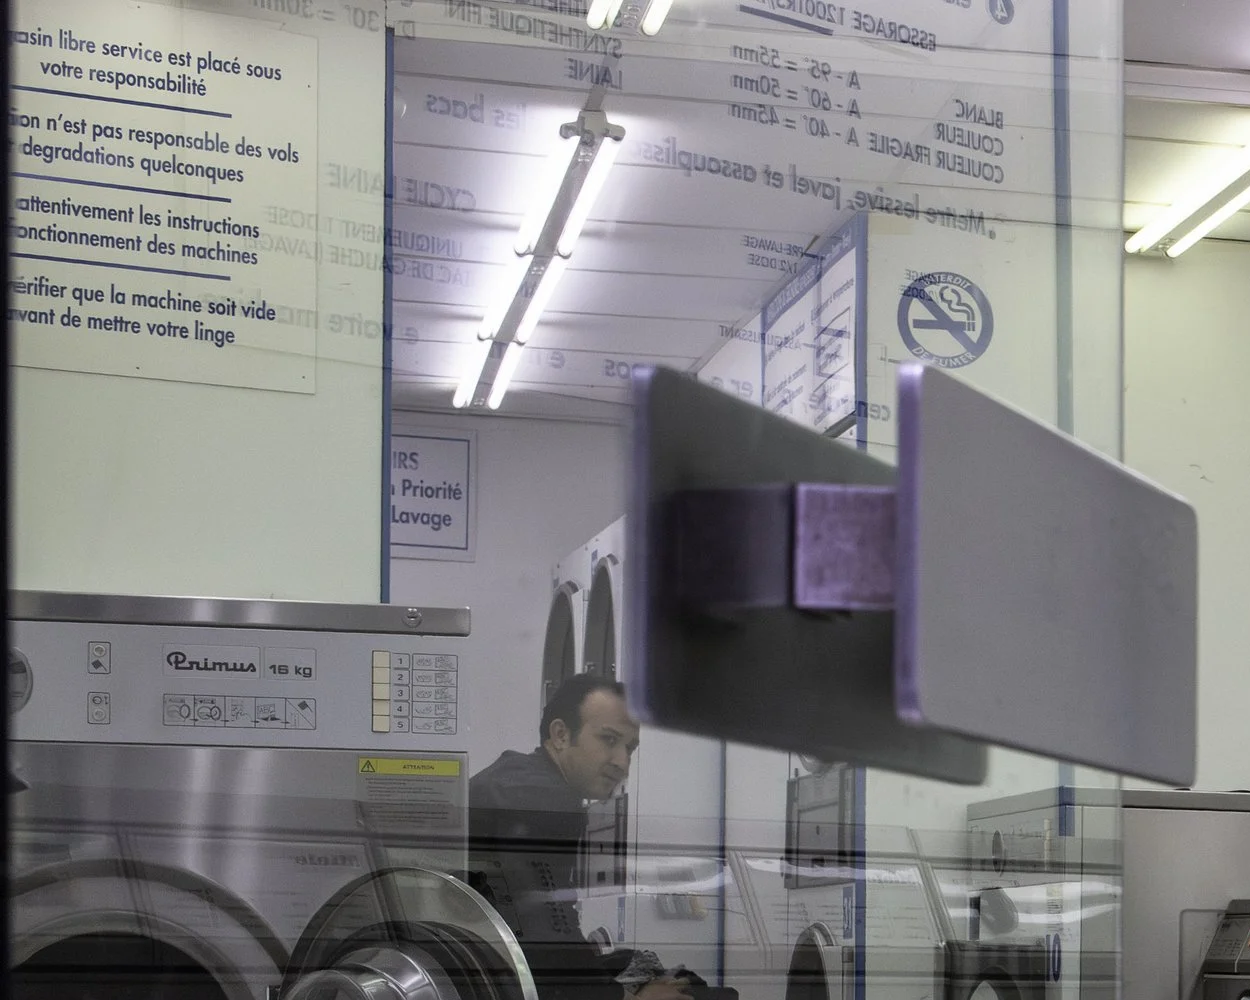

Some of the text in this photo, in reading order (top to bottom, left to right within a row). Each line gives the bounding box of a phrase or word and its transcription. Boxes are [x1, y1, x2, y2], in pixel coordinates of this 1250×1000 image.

[59, 29, 96, 53] libre
[102, 42, 162, 63] service
[168, 51, 191, 67] est
[197, 51, 241, 75] placé
[247, 64, 282, 80] sous
[40, 61, 206, 96] votre responsabilité
[47, 113, 87, 134] n'est
[93, 123, 123, 142] pas
[128, 130, 229, 154] responsable
[235, 136, 262, 158] des
[268, 143, 299, 163] vols
[22, 136, 135, 169] degradations
[141, 154, 244, 184] quelconques
[15, 195, 260, 238] attentivement les instructions
[147, 234, 176, 256] des
[182, 241, 258, 265] machines
[72, 287, 104, 306] que
[111, 284, 125, 304] la
[132, 290, 202, 312] machine
[208, 298, 236, 316] soit
[241, 300, 276, 320] vide
[60, 307, 81, 328] de
[87, 316, 141, 334] mettre
[147, 321, 189, 338] votre
[195, 320, 235, 347] linge
[402, 479, 463, 500] Priorité
[392, 505, 452, 531] Lavage
[166, 651, 257, 673] Primus
[295, 664, 313, 678] kg
